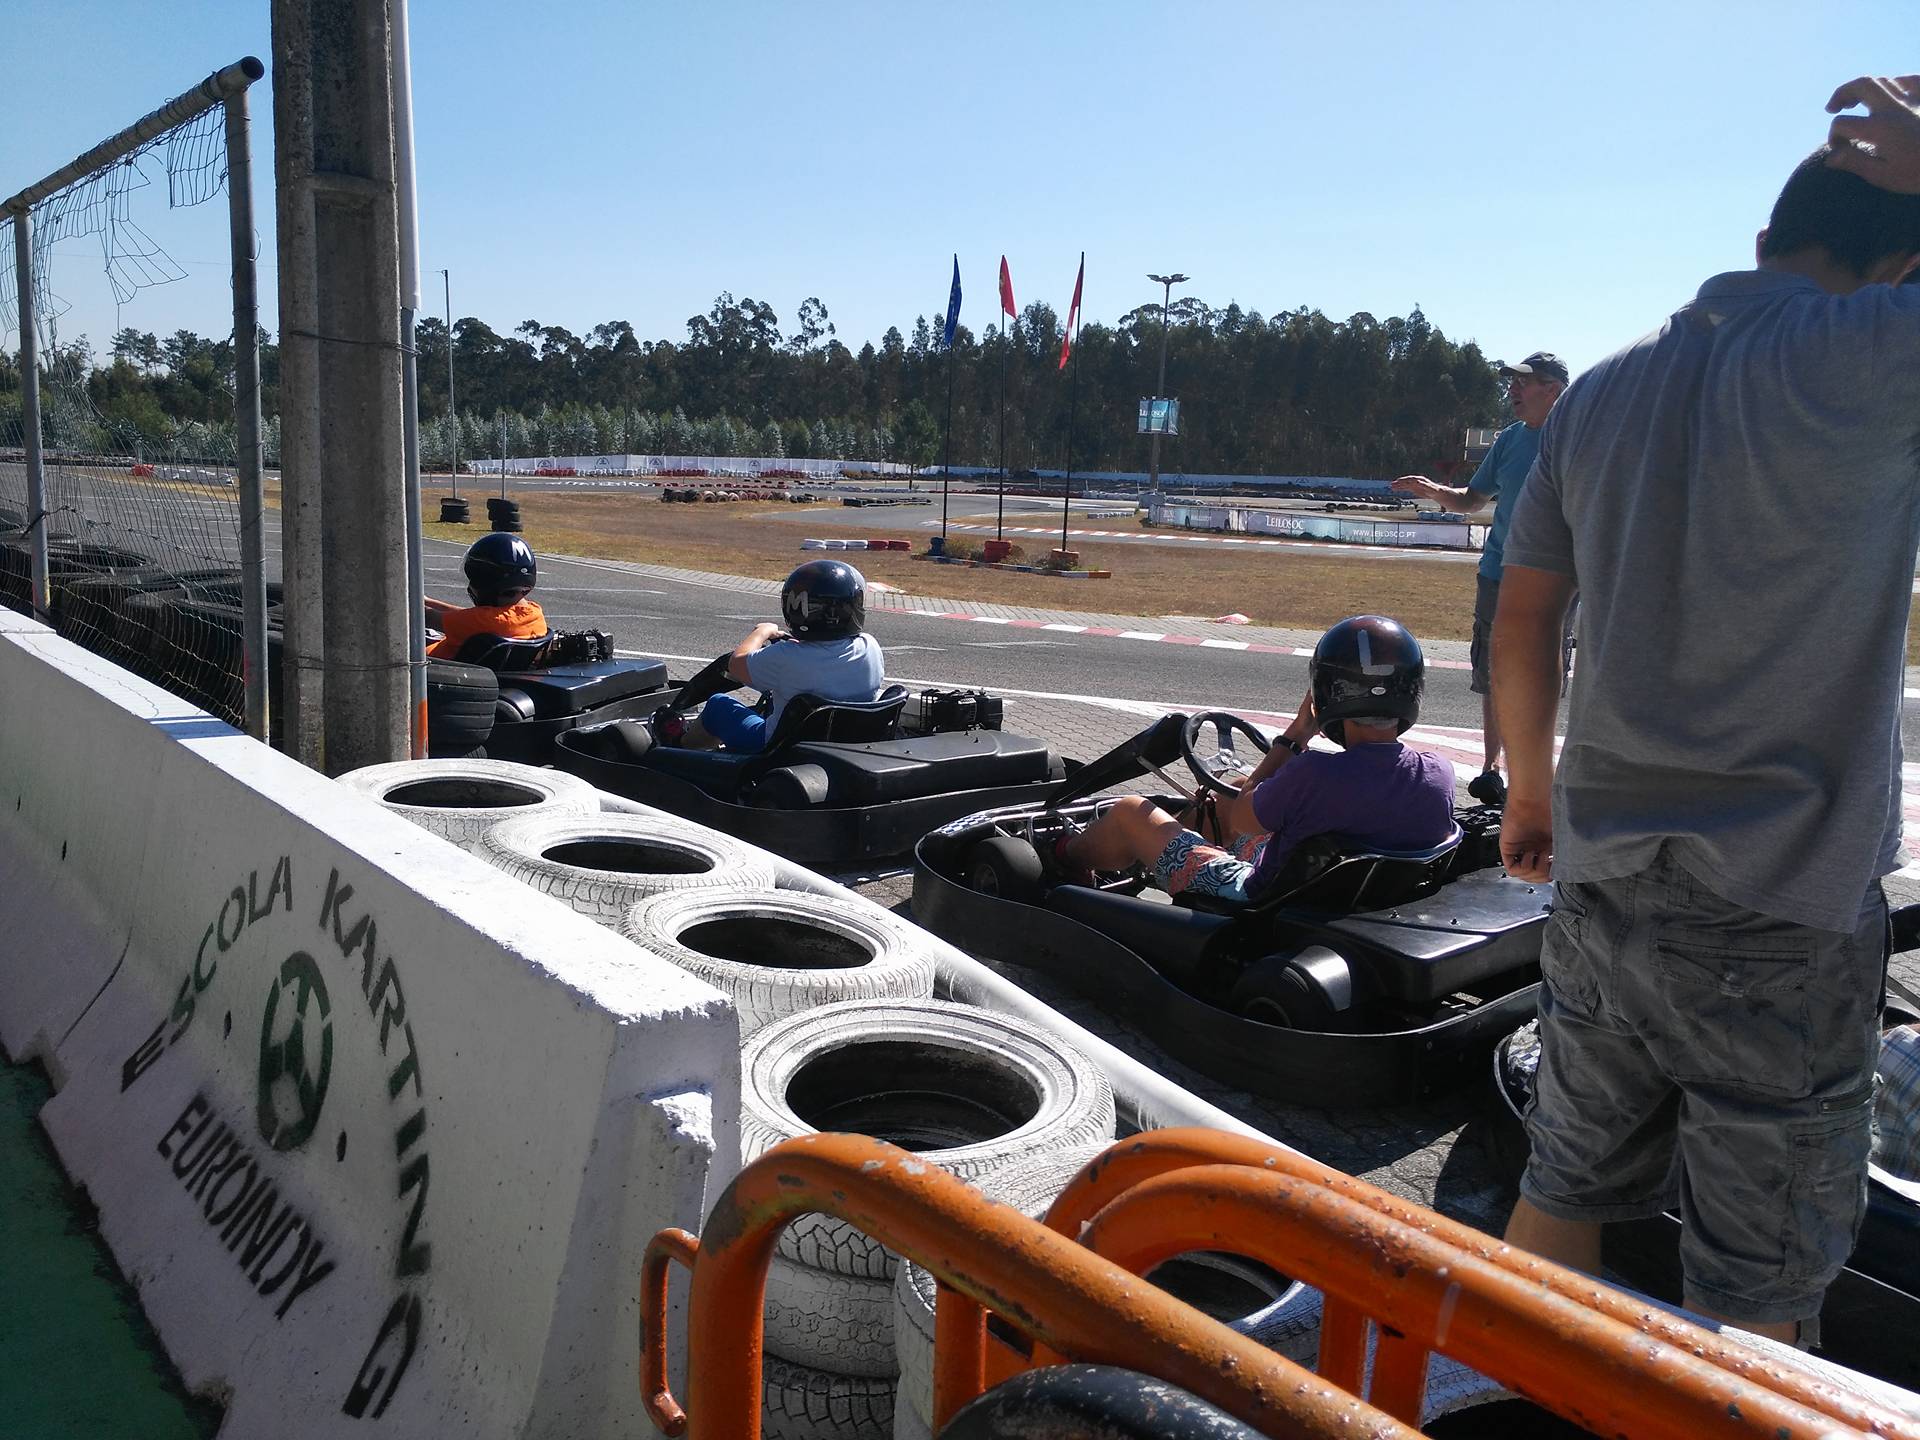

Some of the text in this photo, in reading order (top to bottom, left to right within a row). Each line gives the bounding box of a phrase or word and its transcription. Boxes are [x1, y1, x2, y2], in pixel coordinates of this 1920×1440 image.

[511, 540, 532, 562] M
[786, 589, 809, 618] M
[1357, 629, 1395, 676] L
[121, 855, 431, 1420] ESCOLA KARTING
[156, 1098, 336, 1321] EUROINDY
